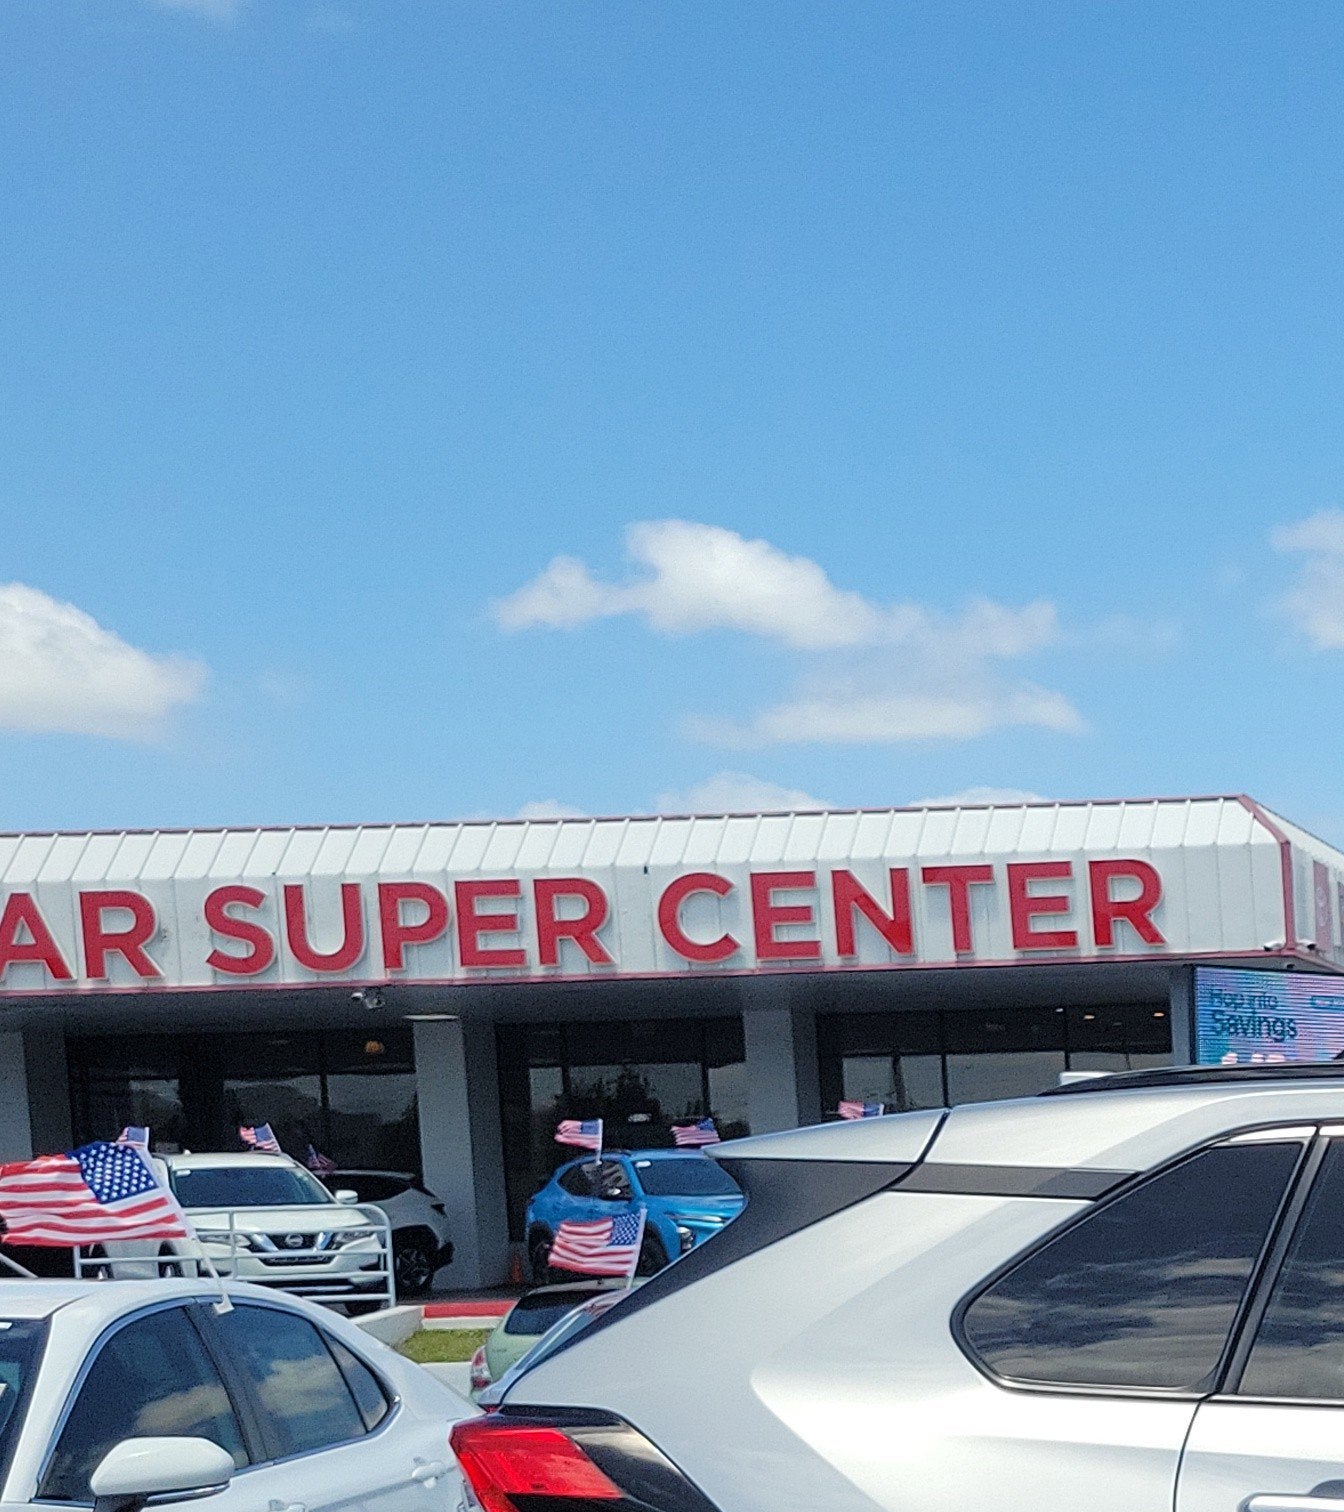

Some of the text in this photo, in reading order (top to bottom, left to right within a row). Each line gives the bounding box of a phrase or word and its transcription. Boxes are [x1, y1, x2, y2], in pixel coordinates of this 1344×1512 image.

[203, 876, 616, 977] SUPER
[657, 859, 1167, 964] CENTER
[1211, 1009, 1298, 1042] Savings
